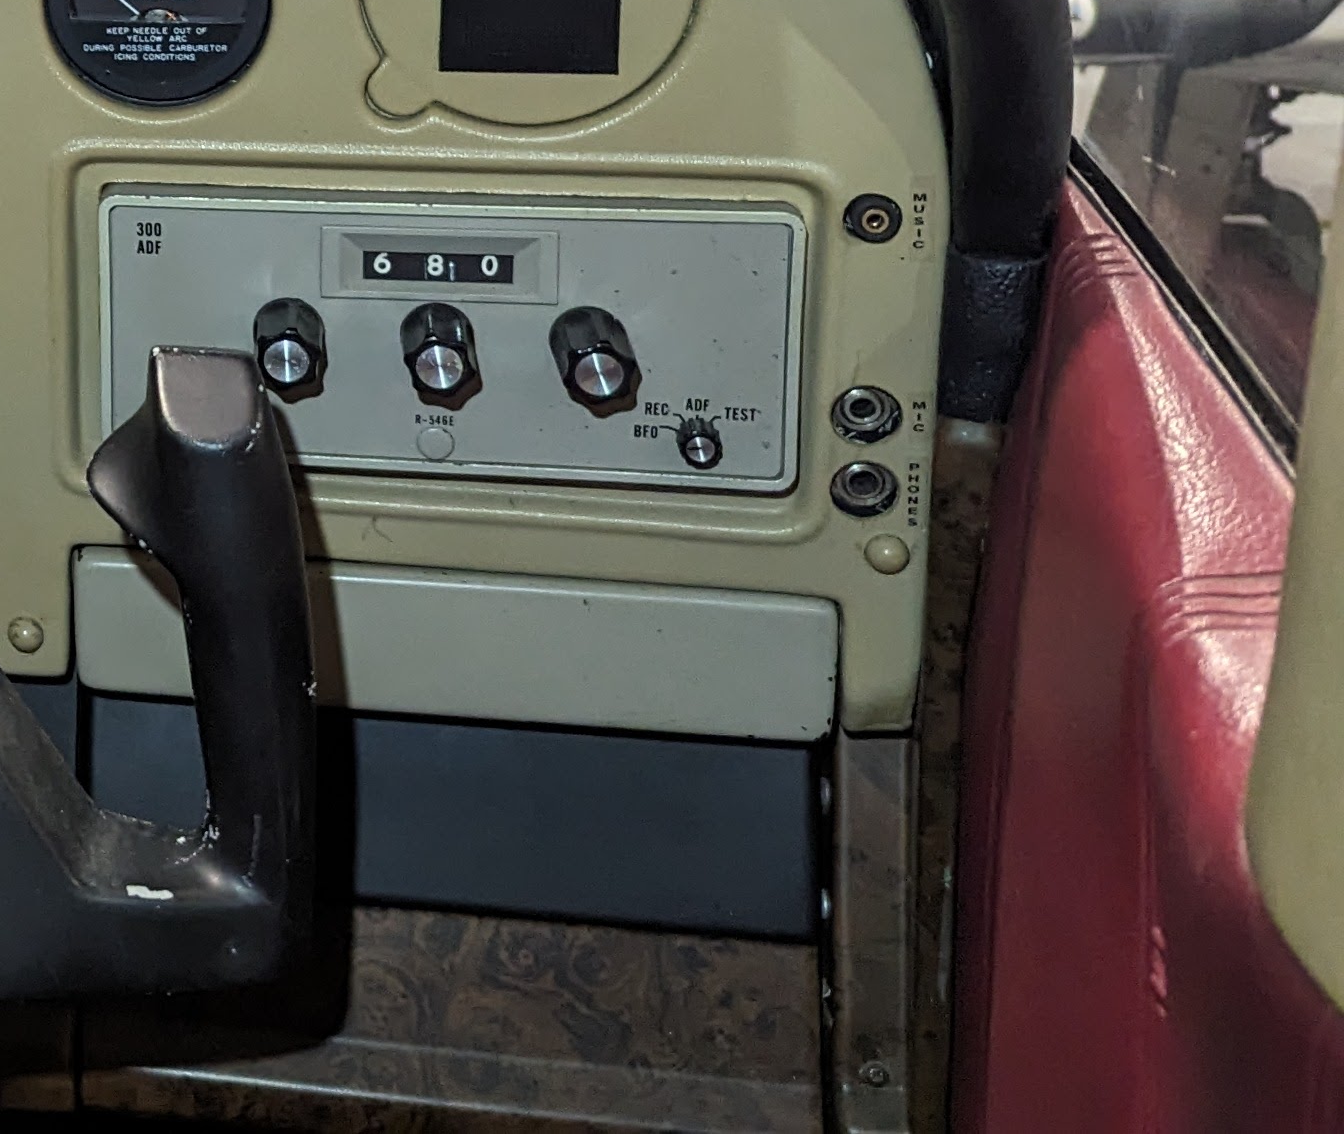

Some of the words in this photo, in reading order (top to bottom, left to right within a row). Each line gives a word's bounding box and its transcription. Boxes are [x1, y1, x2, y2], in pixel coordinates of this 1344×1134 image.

[913, 193, 926, 248] MUSIC
[136, 223, 161, 237] 300
[137, 240, 162, 254] ADF
[373, 252, 391, 274] 6
[427, 254, 444, 276] 8
[481, 255, 499, 276] 0
[645, 403, 669, 415] REC
[685, 398, 709, 411] ADF
[415, 415, 454, 426] R-546E
[725, 407, 756, 421] TEST
[913, 401, 926, 432] MIC
[909, 463, 920, 526] PHONES
